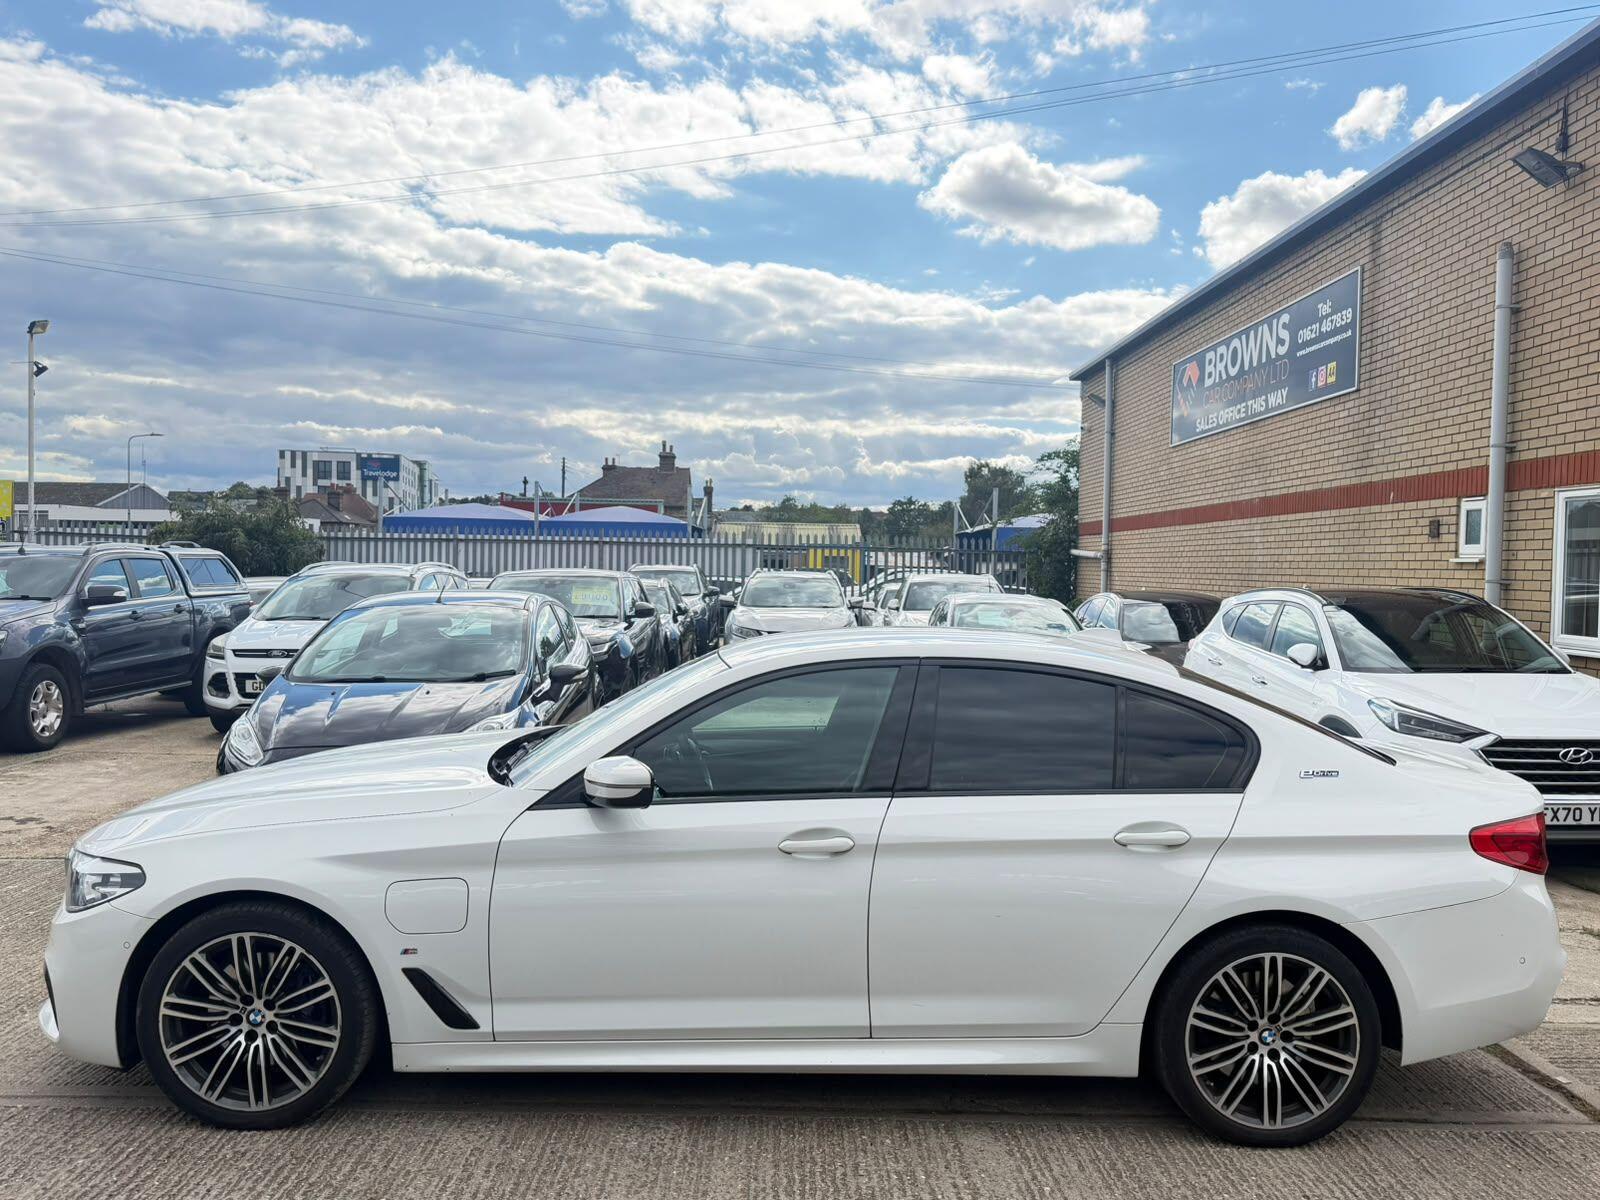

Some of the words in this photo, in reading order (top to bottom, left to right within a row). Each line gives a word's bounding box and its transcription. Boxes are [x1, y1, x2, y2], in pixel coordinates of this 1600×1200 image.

[1297, 322, 1320, 344] 01621
[1320, 307, 1353, 334] 467839
[1318, 299, 1332, 317] Tel:
[1204, 313, 1290, 388] BROWNS
[1203, 386, 1222, 408] CAR
[1222, 367, 1269, 402] COMPANY
[1270, 359, 1290, 384] LTD
[1196, 410, 1218, 432] SALES
[1218, 402, 1246, 425] OFFICE
[1247, 394, 1266, 415] THIS
[1267, 387, 1289, 409] WAY
[1588, 807, 1600, 822] Y
